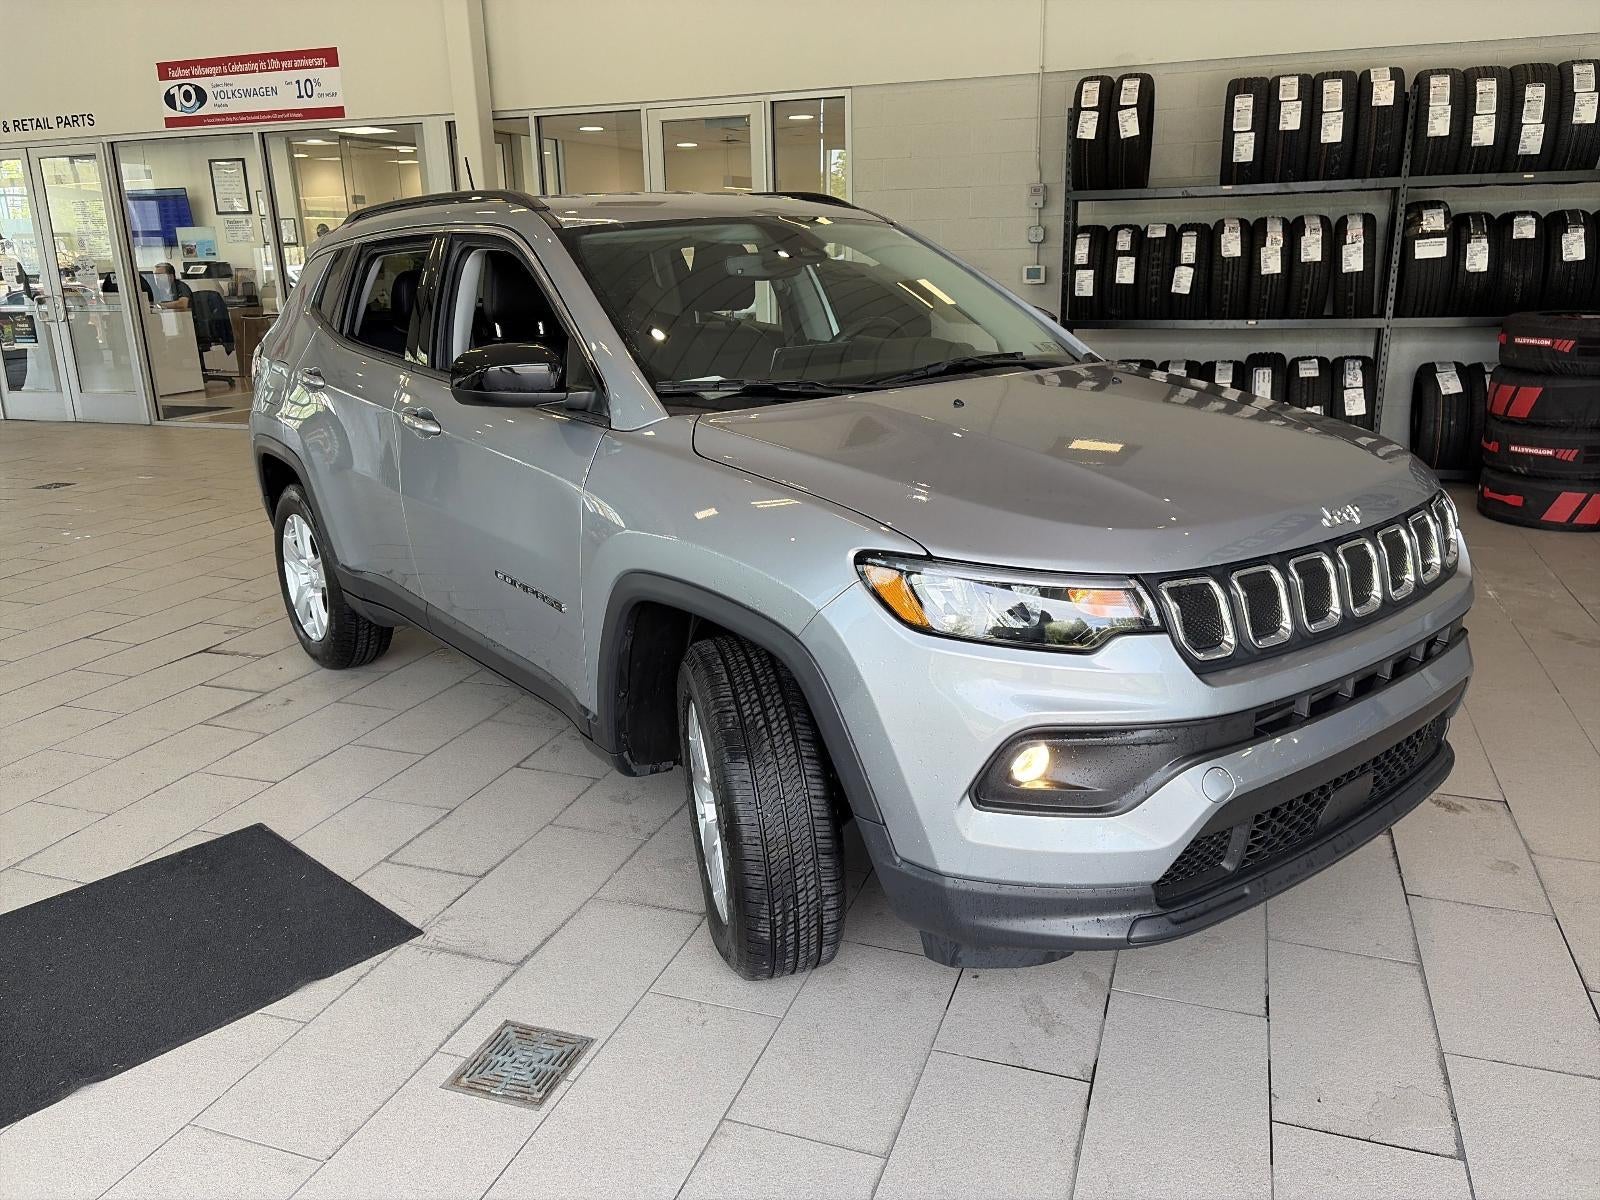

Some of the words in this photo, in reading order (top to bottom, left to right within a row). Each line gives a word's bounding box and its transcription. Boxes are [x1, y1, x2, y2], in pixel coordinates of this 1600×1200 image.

[168, 67, 191, 78] Faulkner
[190, 64, 222, 77] Volkswagen
[222, 63, 228, 73] is
[228, 62, 258, 73] Celebrating
[267, 58, 281, 69] 10th
[281, 59, 292, 71] year
[294, 56, 328, 68] anniversary.
[170, 84, 196, 112] 10
[212, 86, 278, 100] VOLKSWAGEN
[2, 120, 10, 133] &
[13, 118, 54, 132] RETAIL
[56, 113, 95, 128] PARTS
[1510, 446, 1553, 455] MOTOMASTER
[1320, 504, 1362, 528] Jeep
